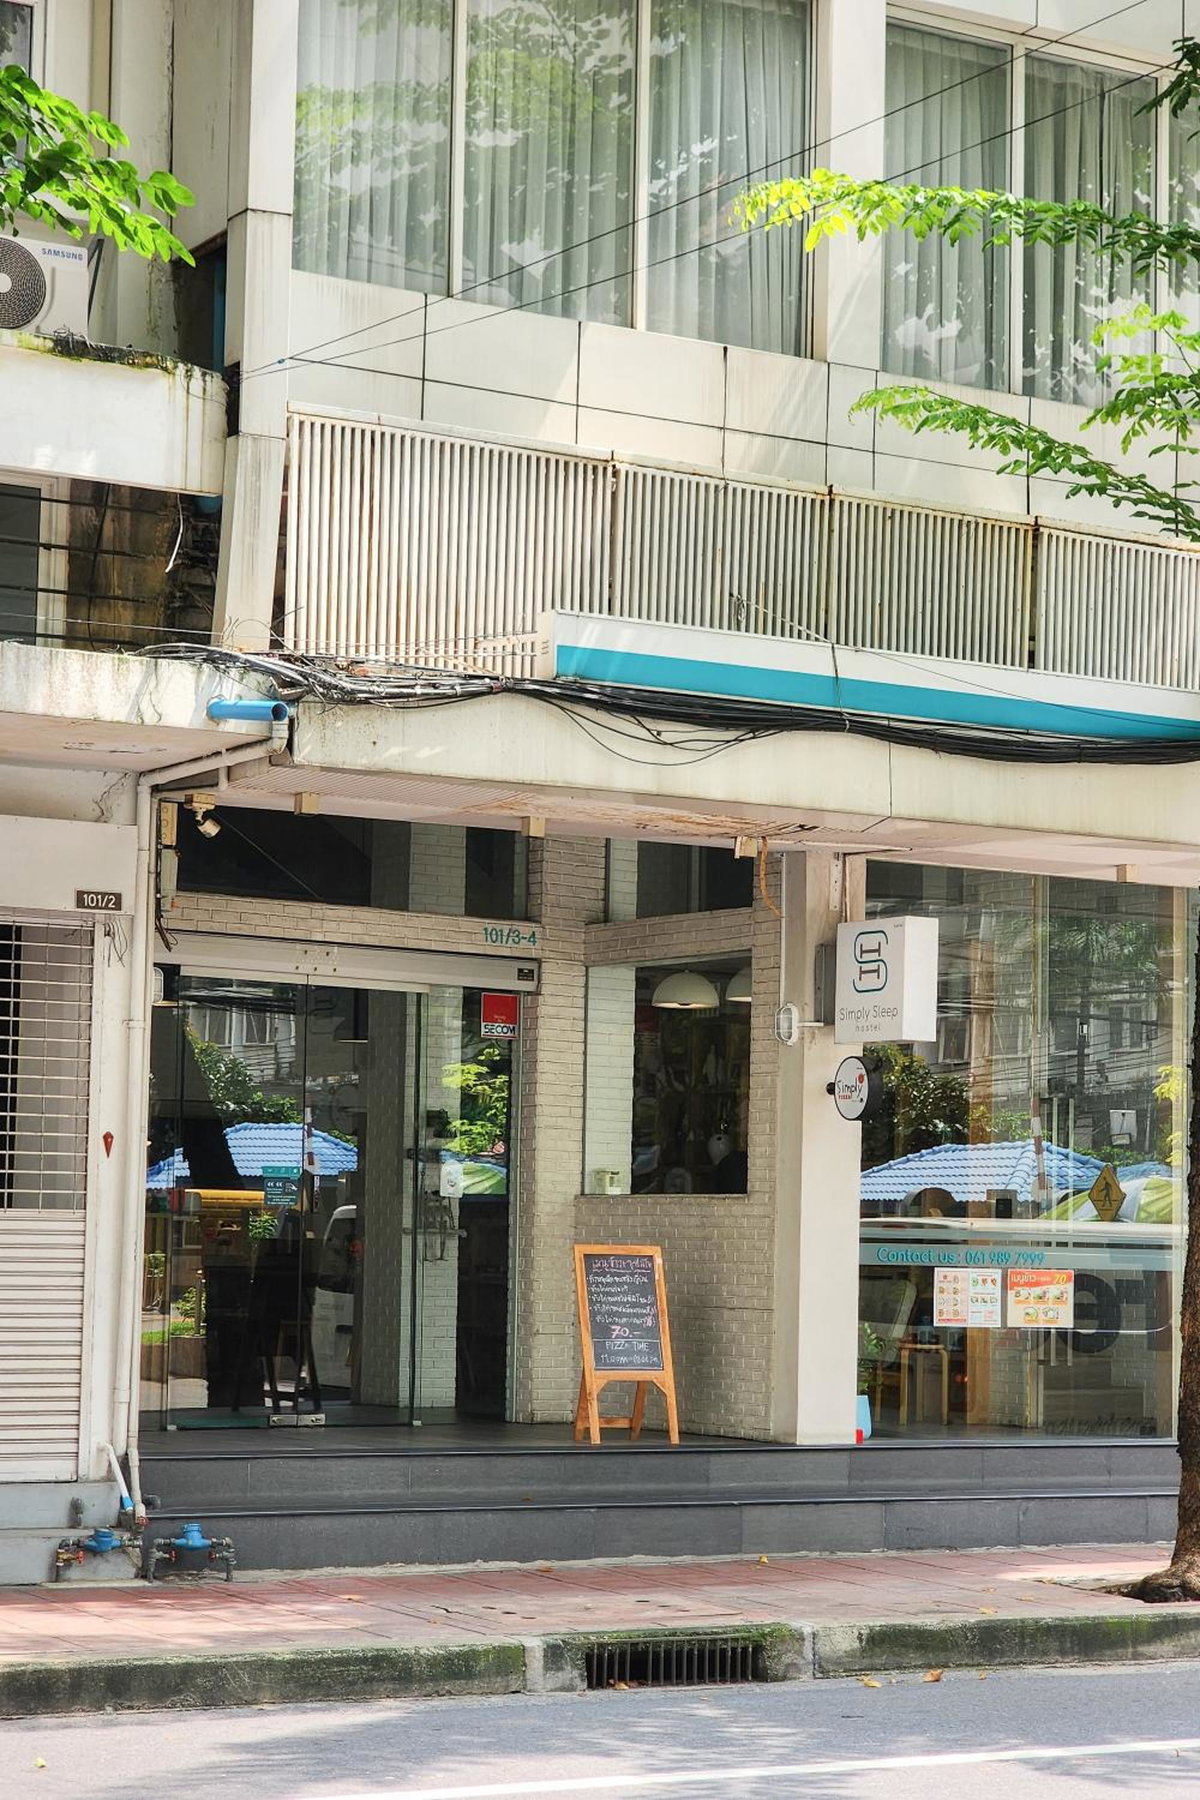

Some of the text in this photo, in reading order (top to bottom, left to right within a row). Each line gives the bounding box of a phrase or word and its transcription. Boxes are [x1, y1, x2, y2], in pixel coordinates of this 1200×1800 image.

[41, 247, 84, 260] SAMSUNG
[83, 893, 116, 908] 101/2
[483, 927, 538, 946] 101/3-4
[839, 1004, 899, 1022] Simply Sleep
[484, 1024, 516, 1036] SECOM
[876, 1247, 933, 1263] Contact
[965, 1250, 986, 1265] 061
[989, 1251, 1011, 1265] 989
[1014, 1251, 1044, 1266] 7999
